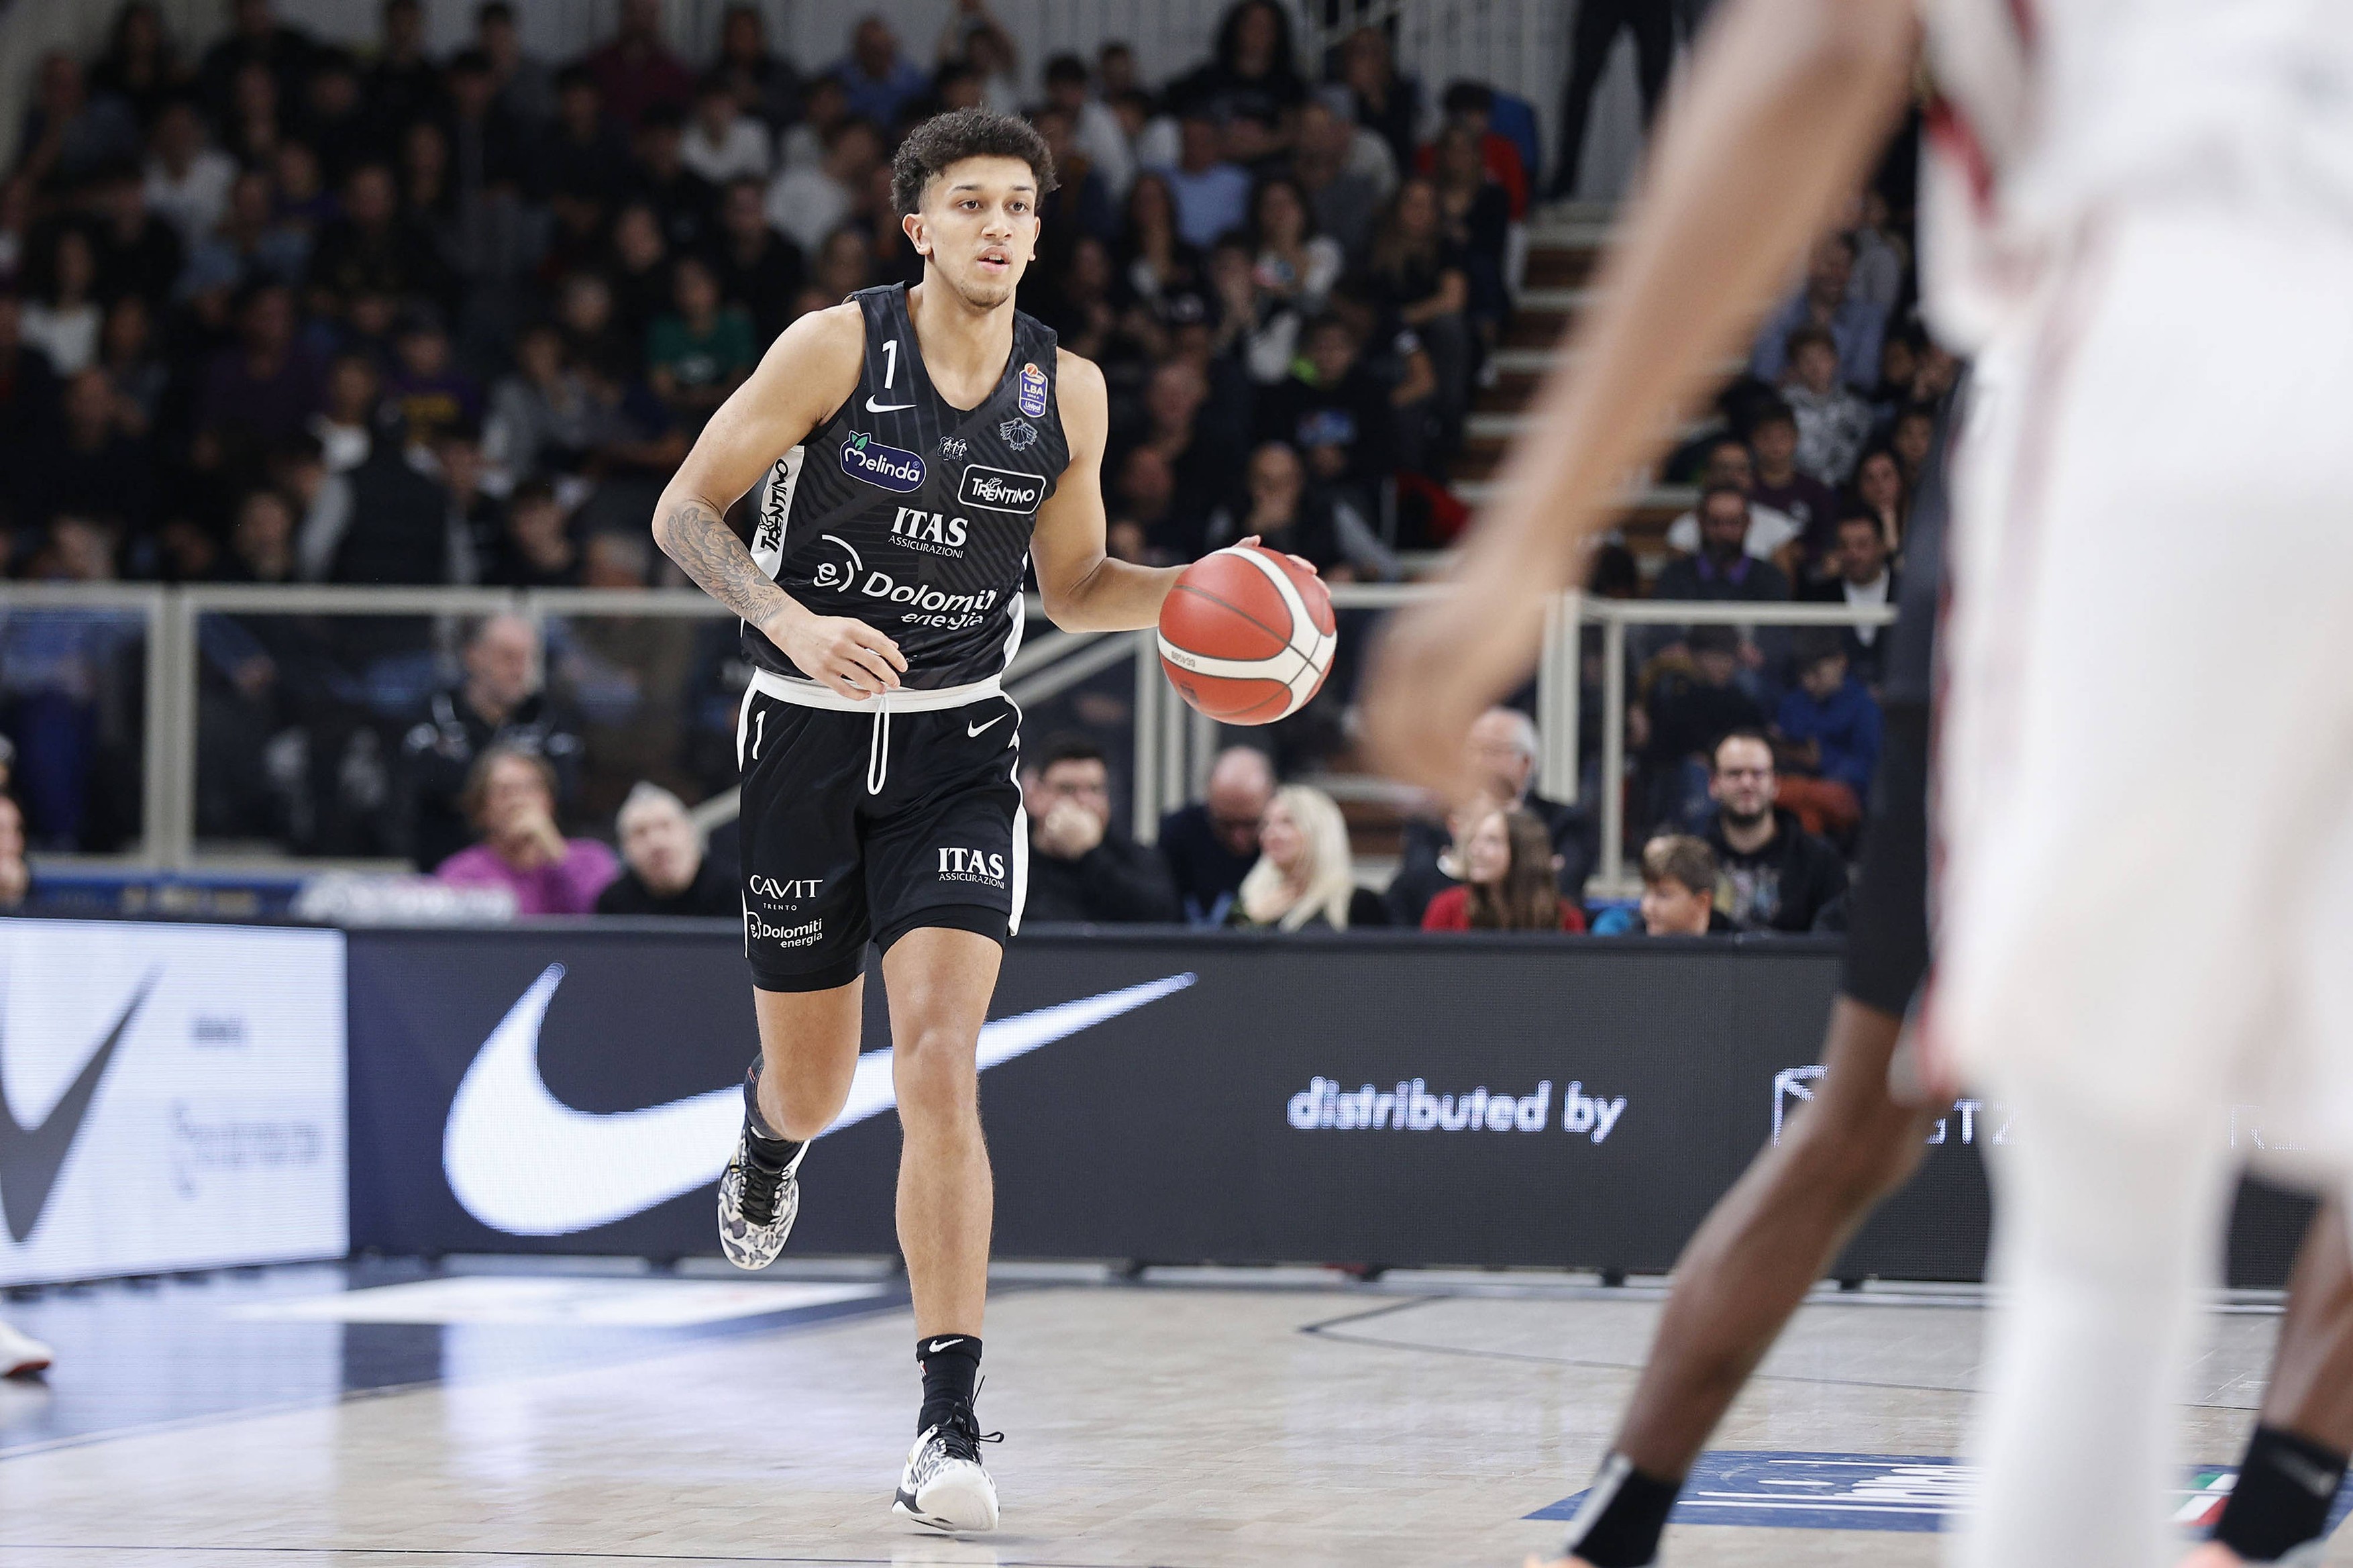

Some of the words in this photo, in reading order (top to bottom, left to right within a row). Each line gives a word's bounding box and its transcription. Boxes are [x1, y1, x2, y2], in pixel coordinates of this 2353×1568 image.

[882, 339, 898, 389] 1
[1024, 383, 1043, 397] LBA
[845, 448, 921, 482] Melinda
[972, 477, 1035, 504] TRENTINO
[760, 458, 788, 553] TRENTINO
[890, 507, 968, 547] ITAS
[888, 535, 963, 559] ASSICURAZIONI
[751, 710, 766, 760] 1
[938, 847, 1005, 880] ITAS
[749, 874, 823, 900] CAVIT
[939, 873, 1004, 890] ASSICURAZIONI
[763, 902, 797, 911] TRENTO
[762, 918, 823, 939] Dolomiti
[780, 933, 823, 949] energia
[1287, 1076, 1552, 1132] distributed
[1561, 1080, 1628, 1145] by
